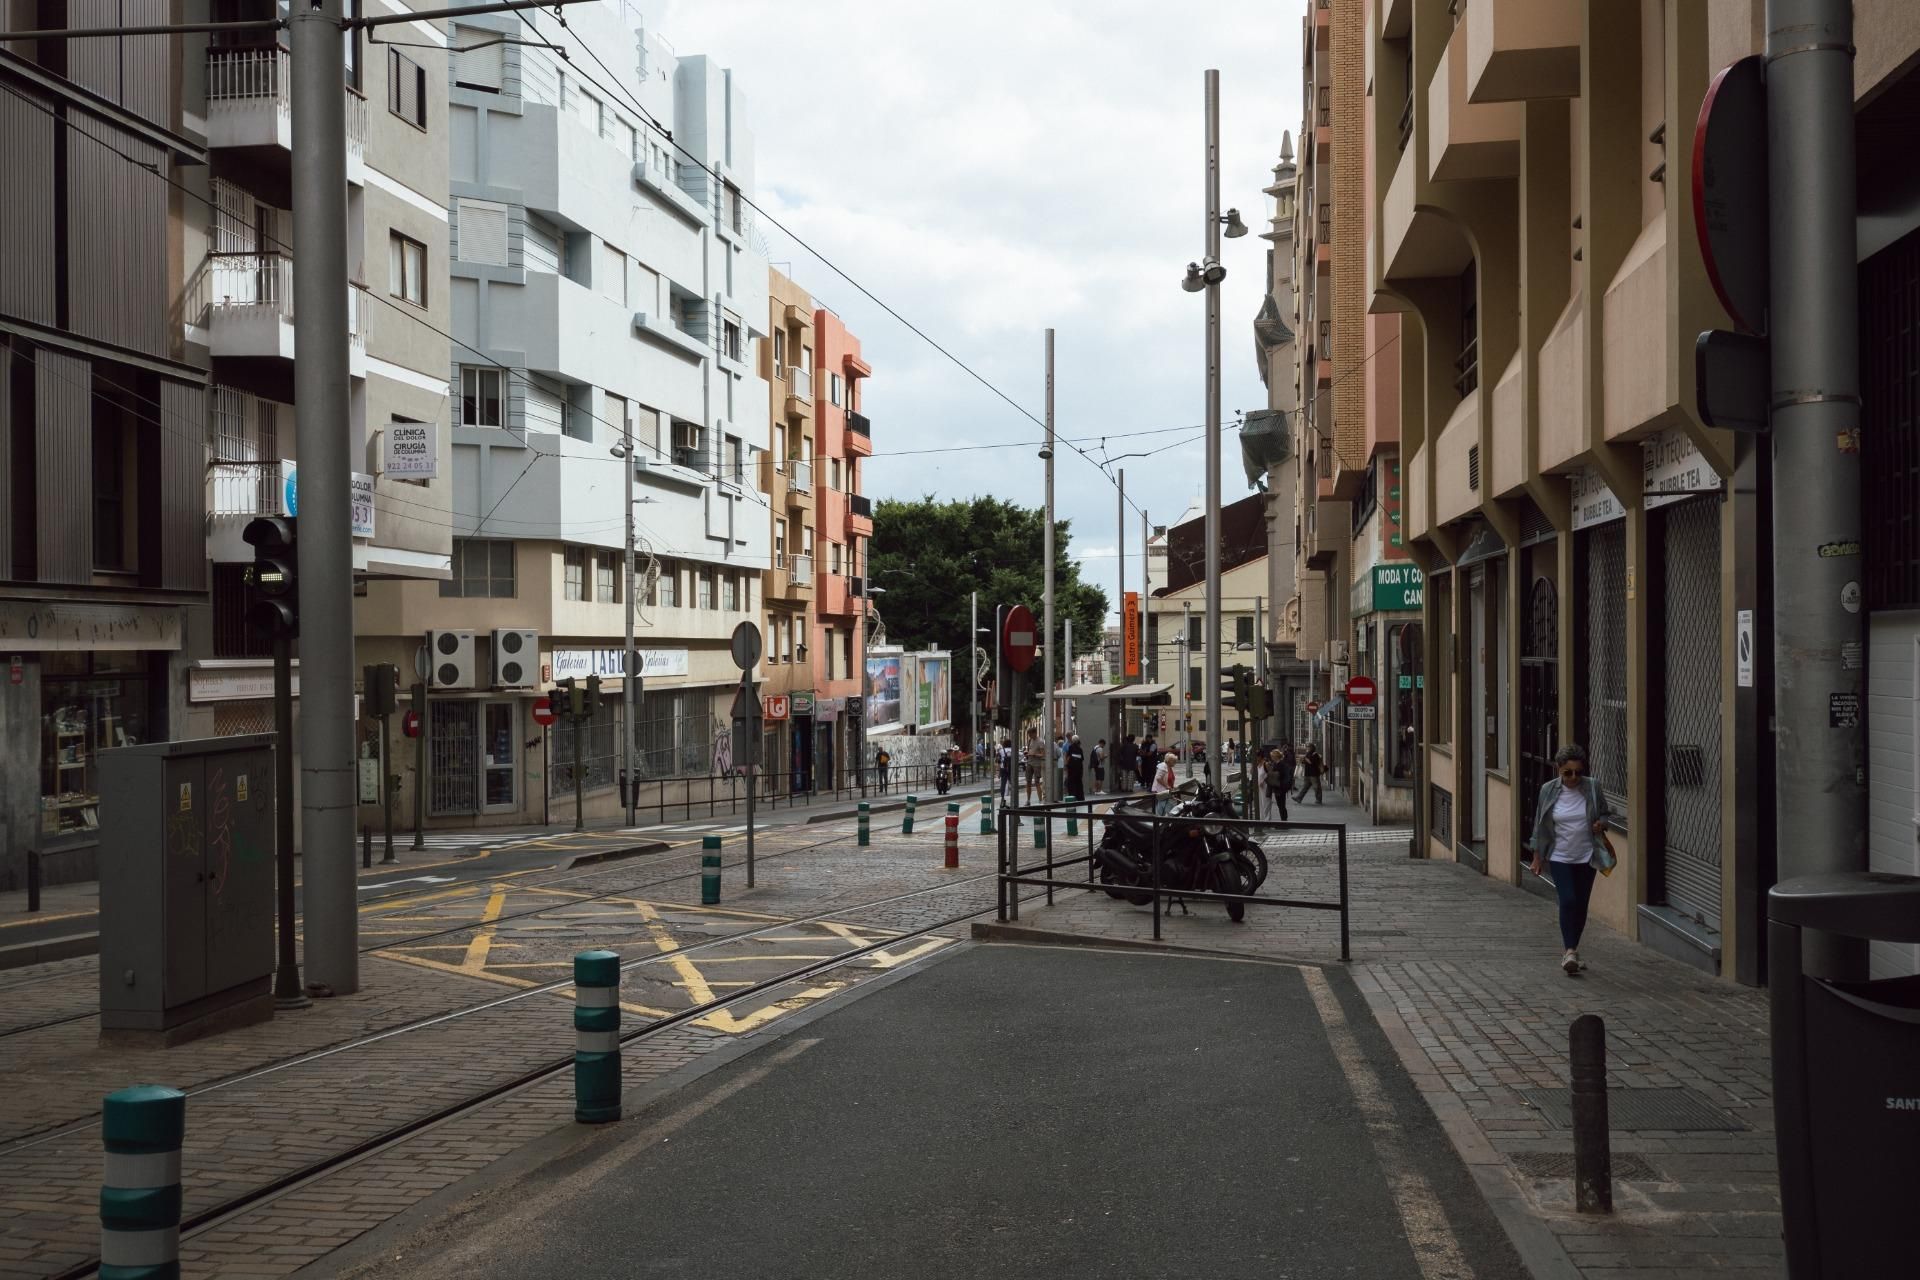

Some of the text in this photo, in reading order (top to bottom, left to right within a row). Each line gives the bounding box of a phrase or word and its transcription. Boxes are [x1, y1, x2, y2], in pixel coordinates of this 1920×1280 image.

[1686, 467, 1700, 488] TEA
[1602, 498, 1613, 515] TEA
[1378, 567, 1423, 585] MODA Y CO
[1404, 589, 1423, 605] CAN
[1128, 641, 1136, 666] Teatro
